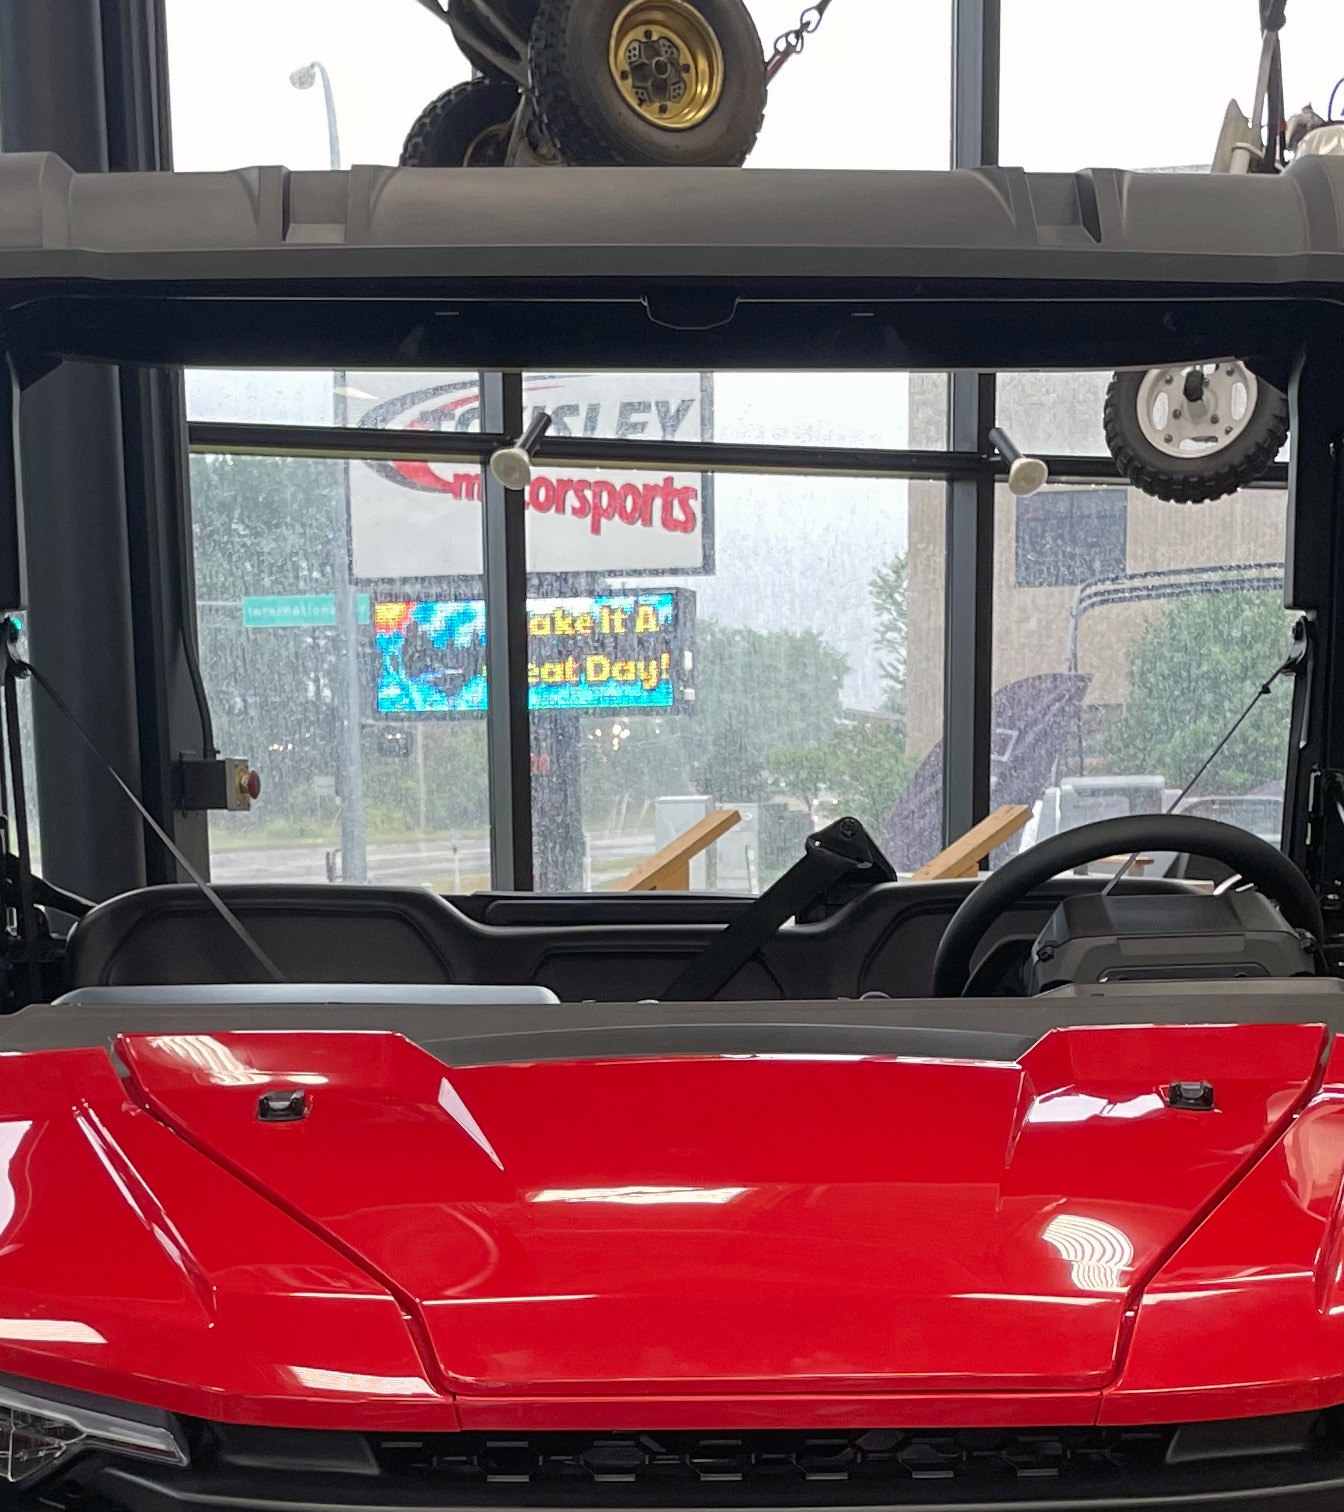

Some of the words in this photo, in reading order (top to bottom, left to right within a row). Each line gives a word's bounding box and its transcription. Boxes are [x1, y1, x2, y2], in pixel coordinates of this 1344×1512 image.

[450, 473, 698, 537] morsports
[529, 606, 594, 636] ake
[600, 604, 628, 634] It
[635, 604, 660, 633] A
[528, 654, 580, 684] eat
[585, 652, 671, 691] Day!
